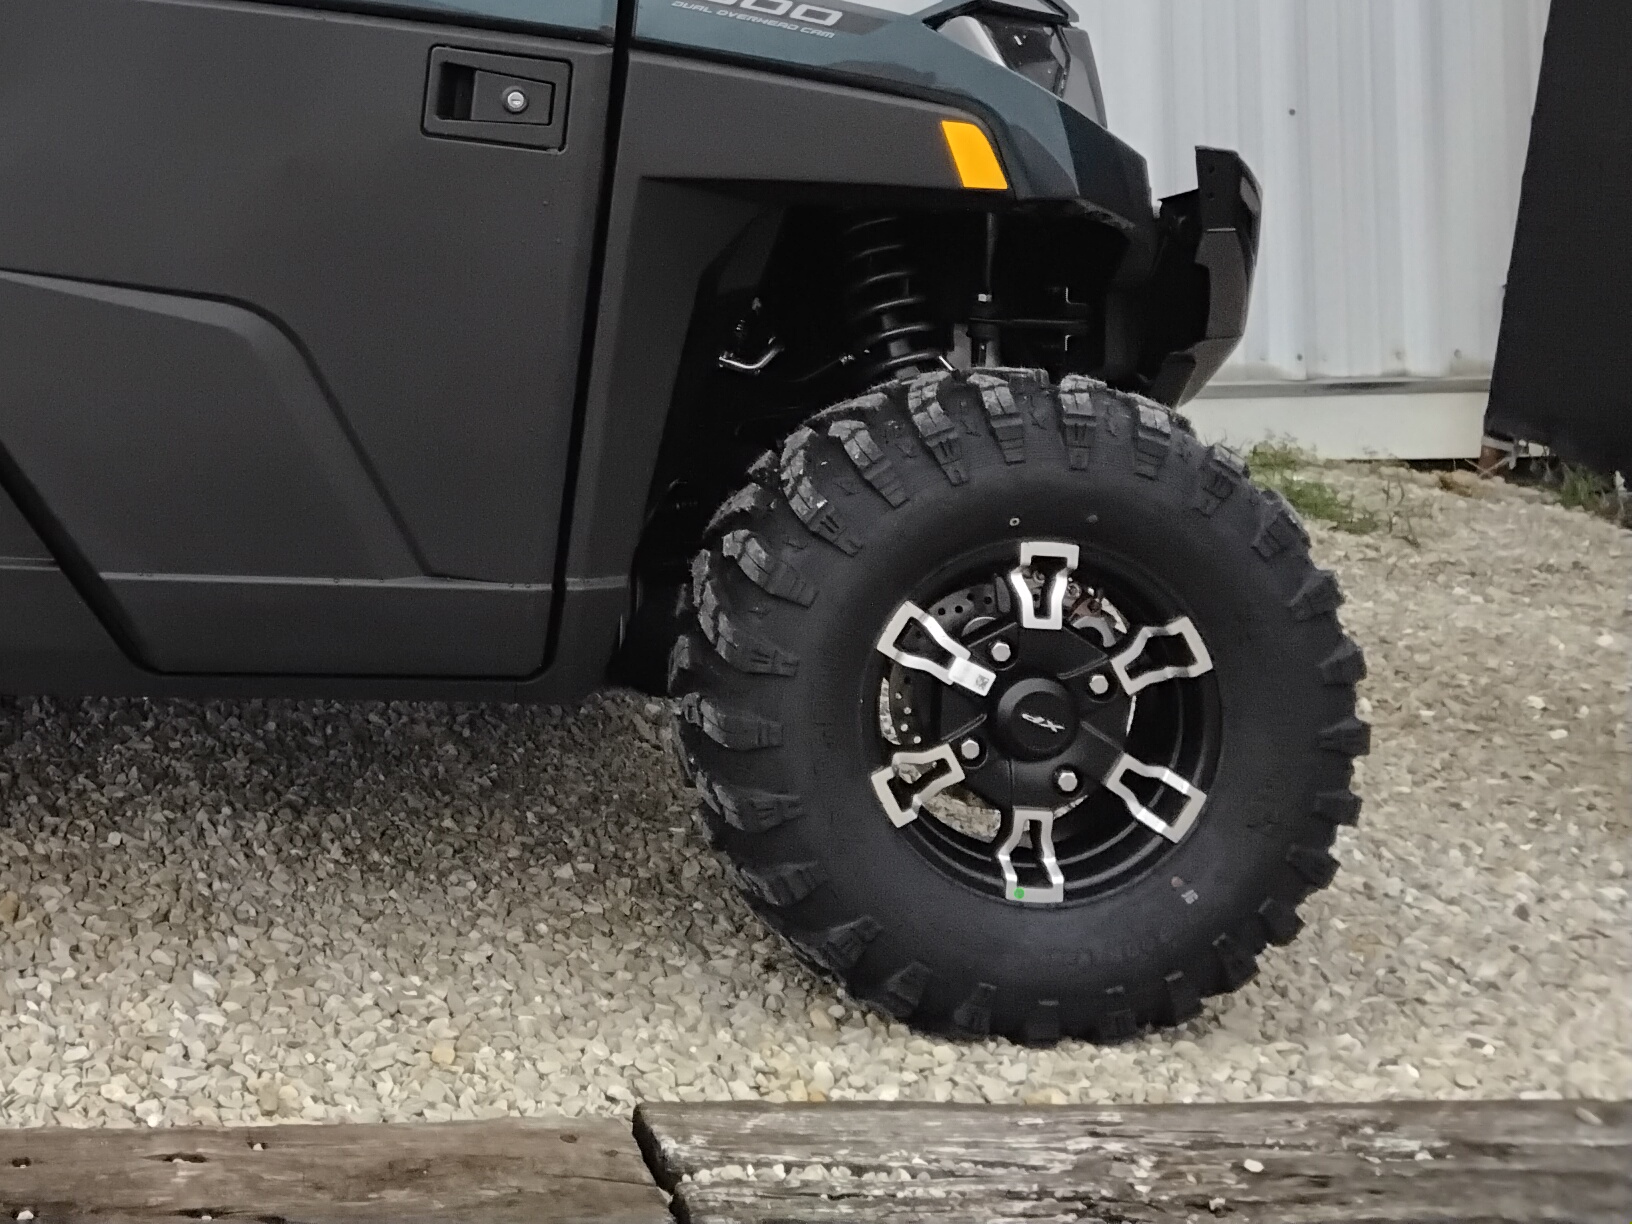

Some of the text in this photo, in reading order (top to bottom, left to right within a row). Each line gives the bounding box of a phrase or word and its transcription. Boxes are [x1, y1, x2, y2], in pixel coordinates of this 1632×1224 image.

[671, 0, 836, 40] DUAL OVERHEAD CAM
